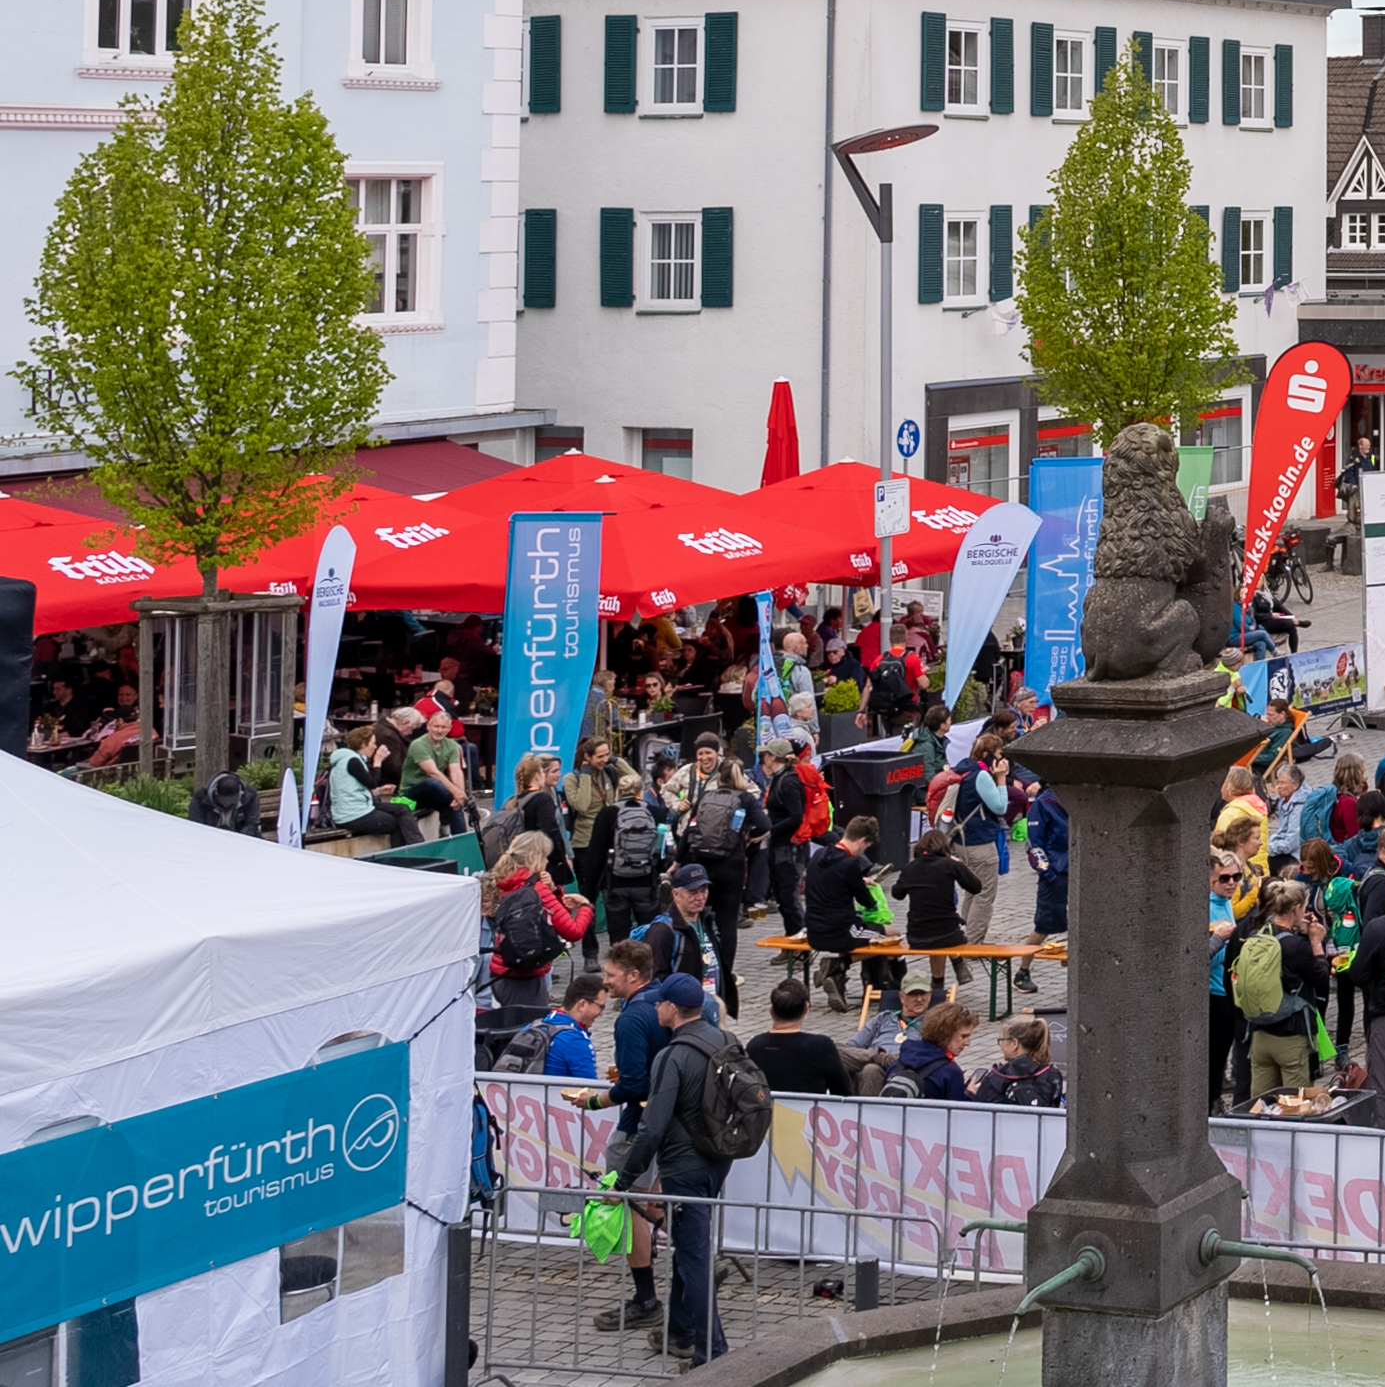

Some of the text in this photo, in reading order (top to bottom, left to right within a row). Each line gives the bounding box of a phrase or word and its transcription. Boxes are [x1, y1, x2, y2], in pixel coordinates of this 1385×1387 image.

[95, 572, 150, 585] KÖLSCH
[967, 548, 1019, 559] BERGISCHE
[971, 558, 1012, 566] WALDQUELLE
[562, 527, 581, 660] tourismus
[523, 527, 561, 753] perfürth
[0, 1118, 335, 1255] wipperfürth
[203, 1161, 335, 1218] tourismus
